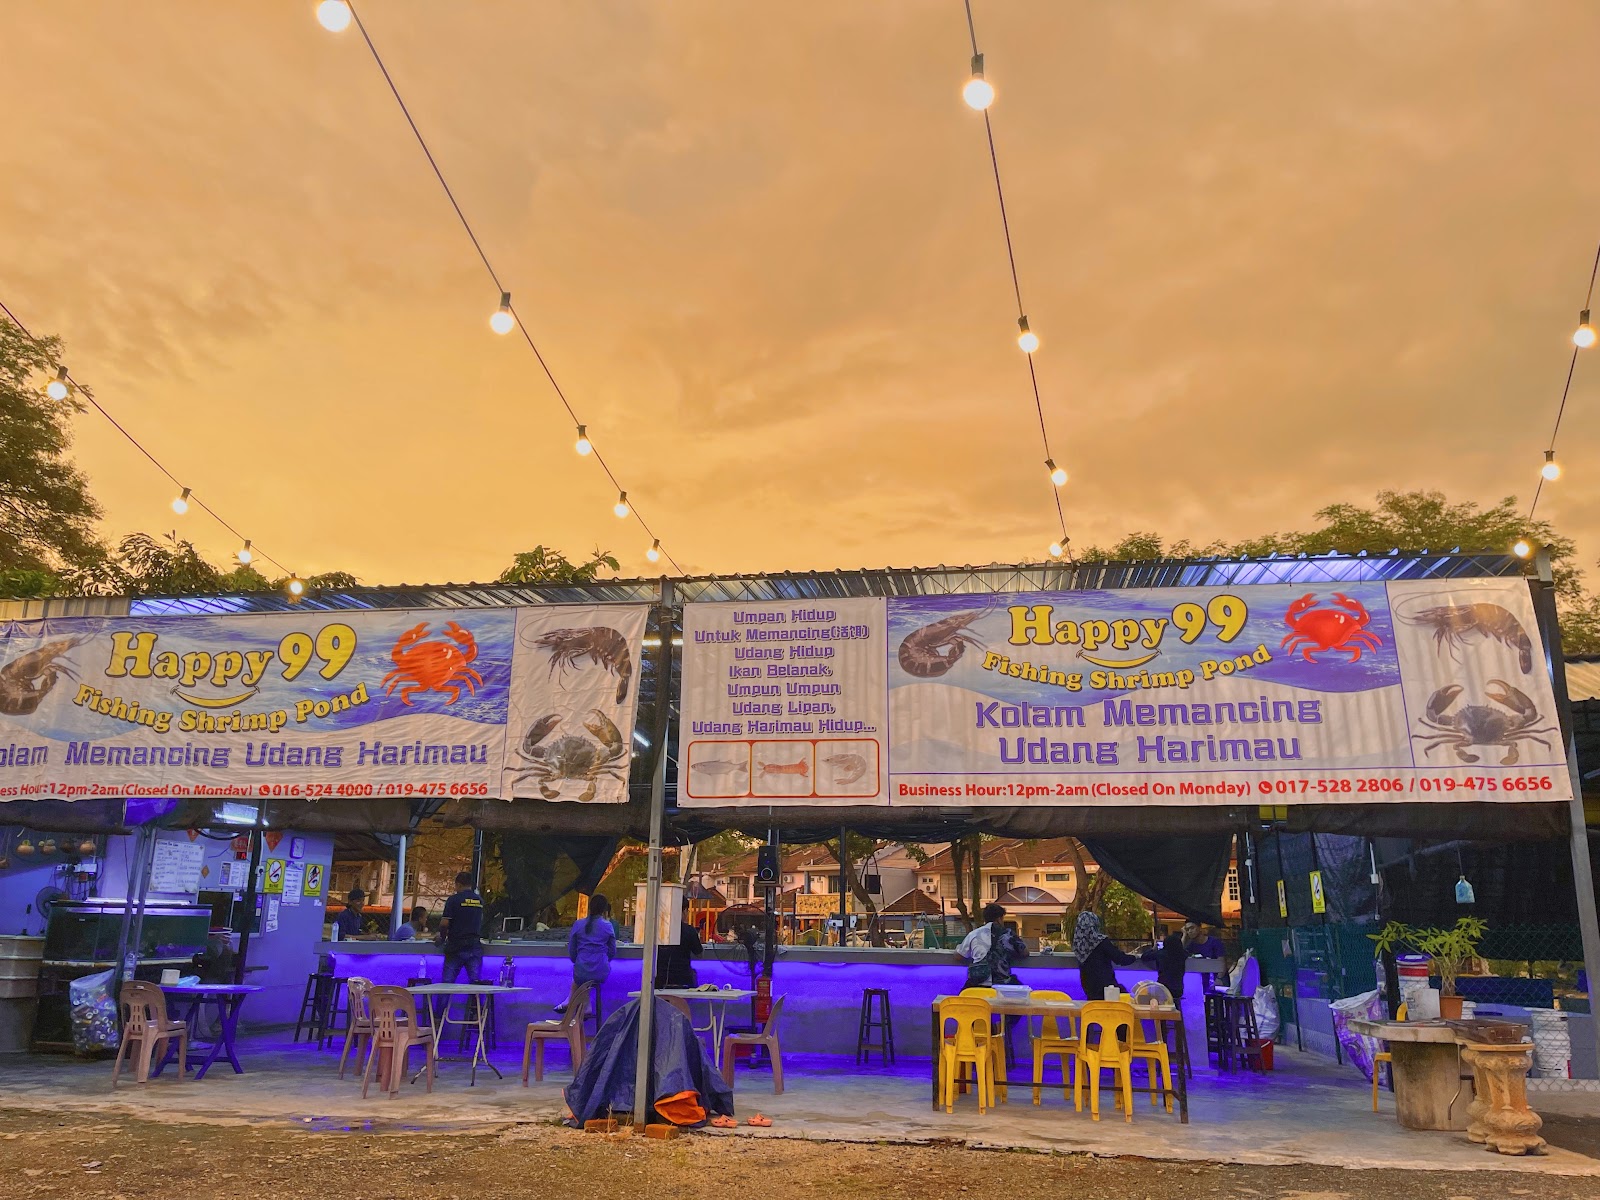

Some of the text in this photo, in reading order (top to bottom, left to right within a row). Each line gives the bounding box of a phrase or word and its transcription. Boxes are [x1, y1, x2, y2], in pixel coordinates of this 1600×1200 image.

[733, 609, 836, 625] Umpan Hidup
[1008, 594, 1248, 651] Happy 99
[695, 630, 741, 643] Untuk
[105, 623, 358, 687] Happy 99
[735, 646, 834, 659] Udang Hidup
[729, 664, 833, 678] Ikan Belanak,
[982, 643, 1272, 691] Fishing Shrimp Pond
[728, 683, 841, 697] Umpun Umpun
[72, 682, 370, 733] Fishing Shrimp Pond
[732, 701, 836, 716] Udang Lipan,
[976, 696, 1322, 728] Kolam Memancing
[692, 719, 876, 735] Udang Harimau Hidup...
[0, 741, 487, 769] olam Memancing Udang Harimau
[999, 735, 1303, 766] Udang Harimau
[121, 784, 169, 796] (Closed
[171, 784, 190, 795] On
[272, 784, 332, 797] 016-524
[336, 784, 373, 796] 4000
[385, 783, 446, 796] 019-475
[449, 782, 488, 796] 6656
[899, 783, 962, 796] Business
[965, 783, 1089, 799] Hour:12pm-2am
[1091, 782, 1149, 797] (Closed
[1152, 782, 1176, 796] On
[1179, 781, 1251, 797] Monday)
[1275, 779, 1352, 794] 017-528
[1356, 778, 1404, 792] 2806
[1419, 777, 1498, 792] 019-475
[1502, 776, 1552, 791] 6656
